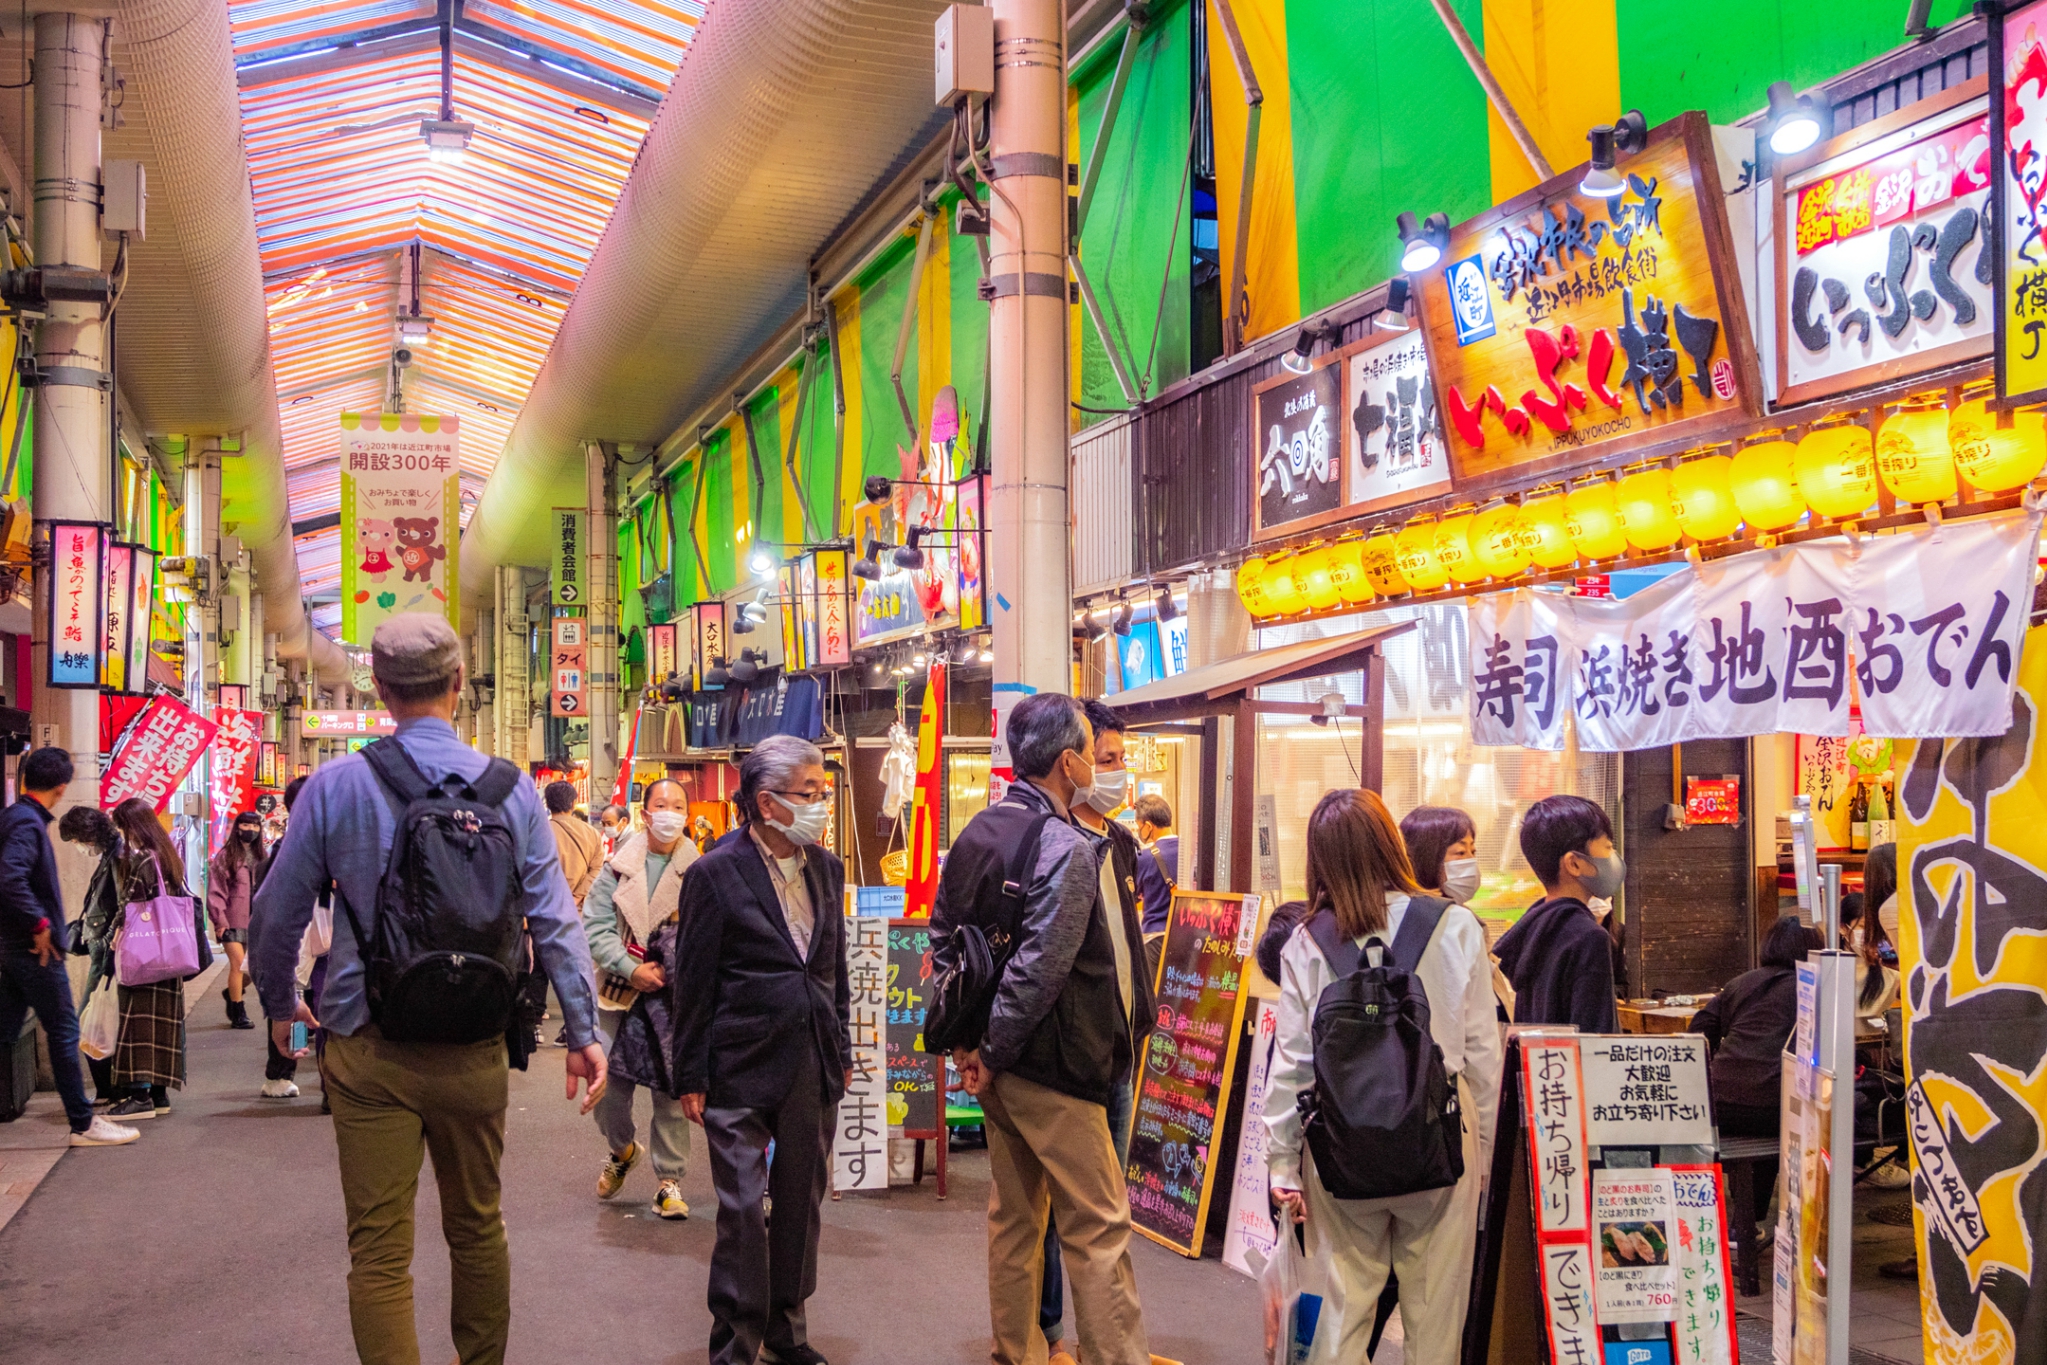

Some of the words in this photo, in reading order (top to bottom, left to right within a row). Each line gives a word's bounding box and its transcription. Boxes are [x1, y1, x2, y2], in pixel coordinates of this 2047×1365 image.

[1553, 416, 1632, 449] IPPUKUYOKOCHO
[370, 442, 452, 453] 2021年は近江町市場
[349, 452, 452, 473] 開設300年
[369, 488, 431, 498] おみちょで楽しく
[384, 498, 417, 507] お買い物
[561, 513, 577, 582] 消費者会館
[1586, 588, 1600, 597] 235
[825, 561, 841, 656] 世のために人のために
[556, 653, 581, 666] タイ
[1474, 632, 1558, 730] 寿司
[1577, 629, 1695, 721] 浜焼き
[1699, 597, 1846, 713] 地酒
[1856, 589, 2014, 698] おでん
[104, 706, 182, 804] 出来ます
[1815, 736, 1834, 812] 金沢おでん
[1594, 1045, 1697, 1063] 一品だけの注文
[1624, 1064, 1671, 1082] 大歓迎
[894, 1081, 919, 1092] OK
[1619, 1084, 1679, 1102] お気軽に
[1592, 1103, 1706, 1122] お立ち寄り下さい
[1537, 1049, 1576, 1227] お持ち帰り
[1673, 1180, 1712, 1202] おでん
[1697, 1216, 1722, 1331] お持ち帰り
[1549, 1250, 1587, 1365] できま
